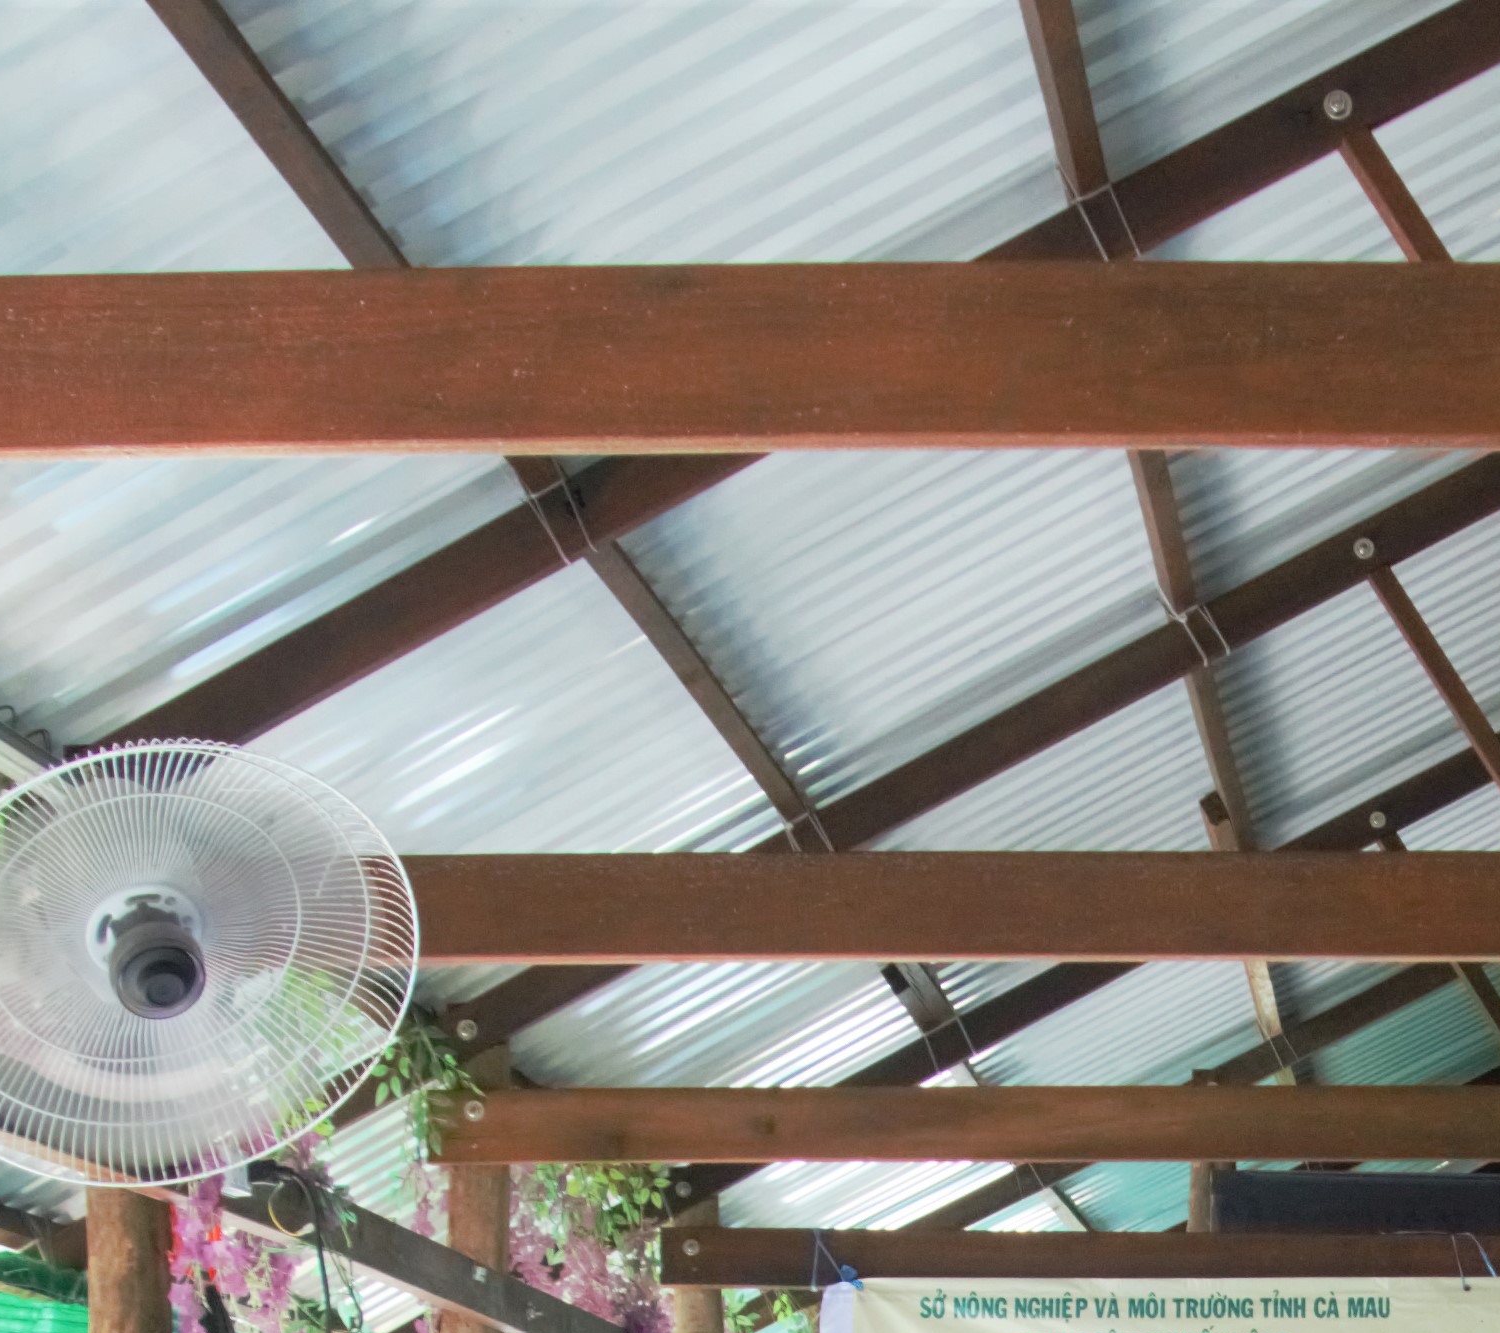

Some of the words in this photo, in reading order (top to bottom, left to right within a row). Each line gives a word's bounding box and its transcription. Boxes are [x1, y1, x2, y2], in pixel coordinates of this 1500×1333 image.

[920, 1288, 947, 1319] SỞ
[953, 1291, 1007, 1319] NÔNG
[1014, 1291, 1088, 1323] NGHIỆP
[1095, 1292, 1120, 1319] VÀ
[1128, 1291, 1166, 1319] MÔI
[1173, 1291, 1254, 1319] TRƯỜNG
[1260, 1289, 1306, 1319] TỈNH
[1313, 1291, 1339, 1318] CÀ
[1347, 1296, 1390, 1319] MAU
